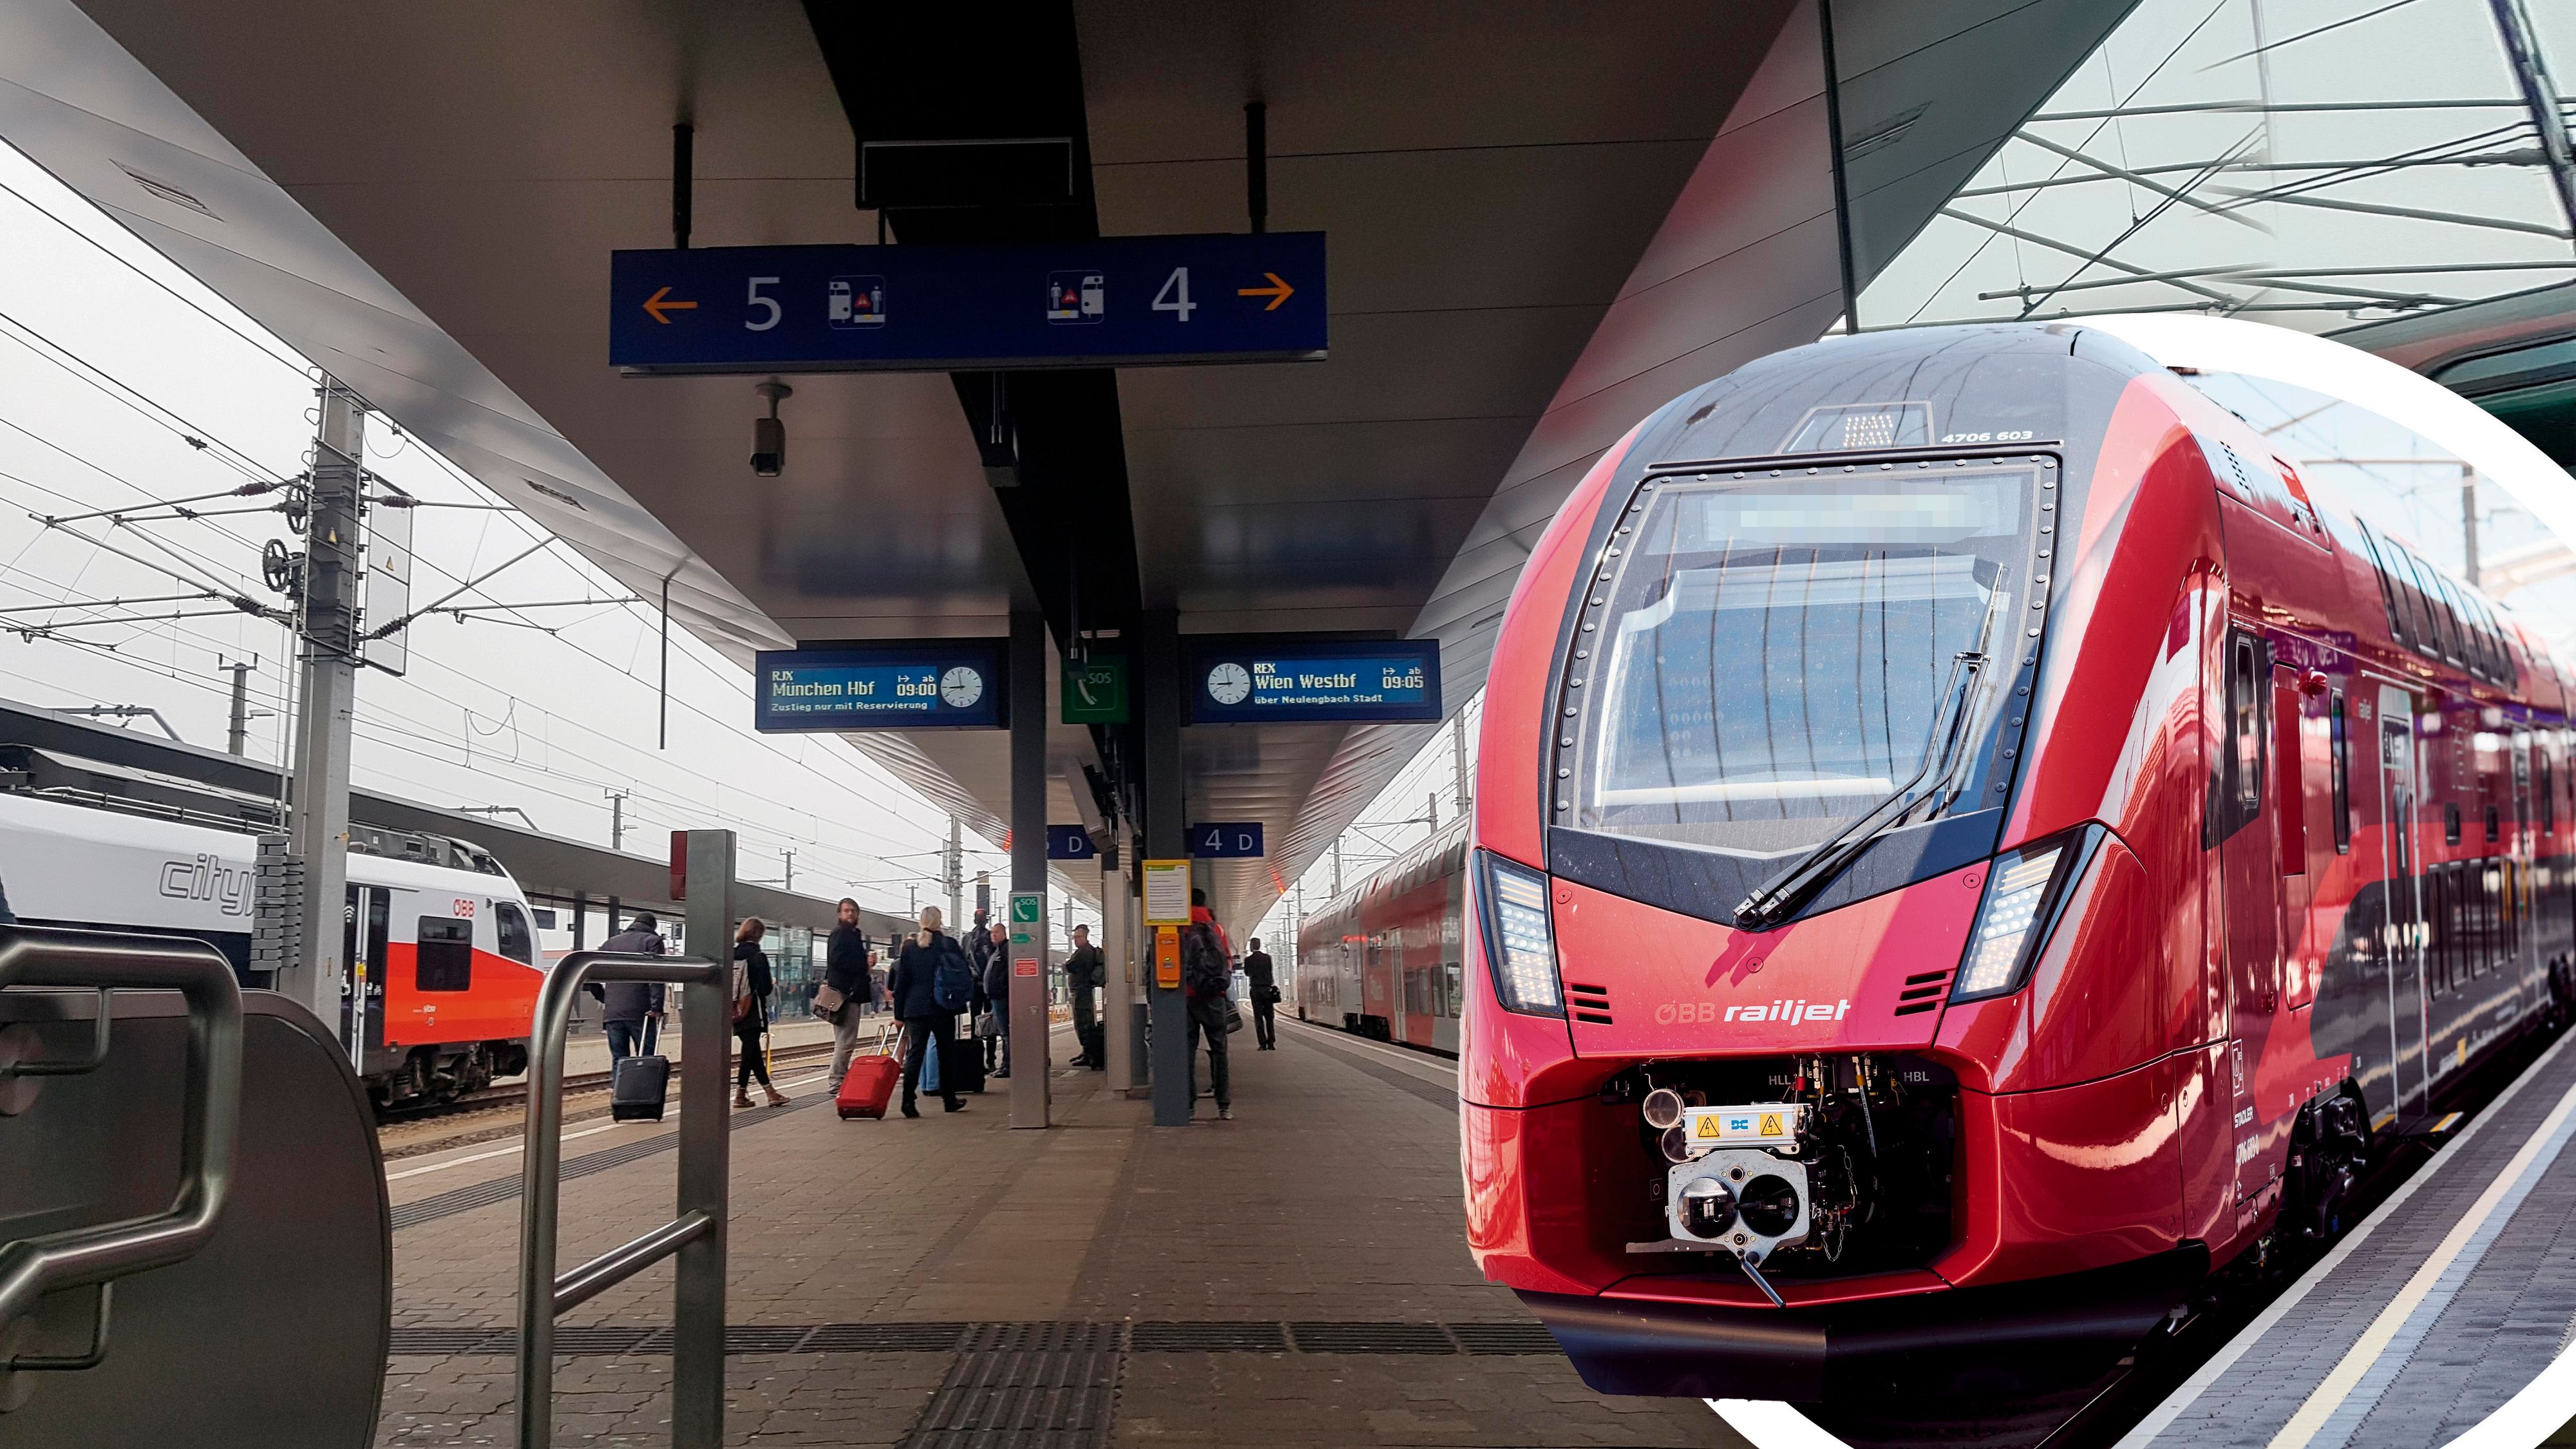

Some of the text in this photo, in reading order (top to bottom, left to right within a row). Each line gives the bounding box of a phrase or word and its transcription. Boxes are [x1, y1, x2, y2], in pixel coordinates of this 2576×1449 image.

[1151, 267, 1197, 322] 4
[745, 277, 782, 332] 5
[1942, 430, 2032, 443] 4706 603
[1254, 663, 1276, 674] REX
[772, 670, 793, 681] RJX
[1088, 672, 1112, 683] SOS
[1255, 674, 1356, 690] Wien Westbf
[773, 681, 875, 697] München Hbf
[1382, 676, 1424, 689] 09:05
[896, 683, 936, 696] 09:00
[1255, 694, 1383, 705] über Neulengbach Stadt
[772, 702, 811, 712] Zustieg
[856, 701, 927, 711] Reservierung
[1069, 836, 1083, 853] D
[1205, 829, 1253, 851] 4 D
[1654, 999, 1852, 1026] ÖBB railjet
[1768, 1075, 1792, 1085] HLL
[1903, 1071, 1929, 1082] HBL
[2235, 1105, 2253, 1128] STADLER
